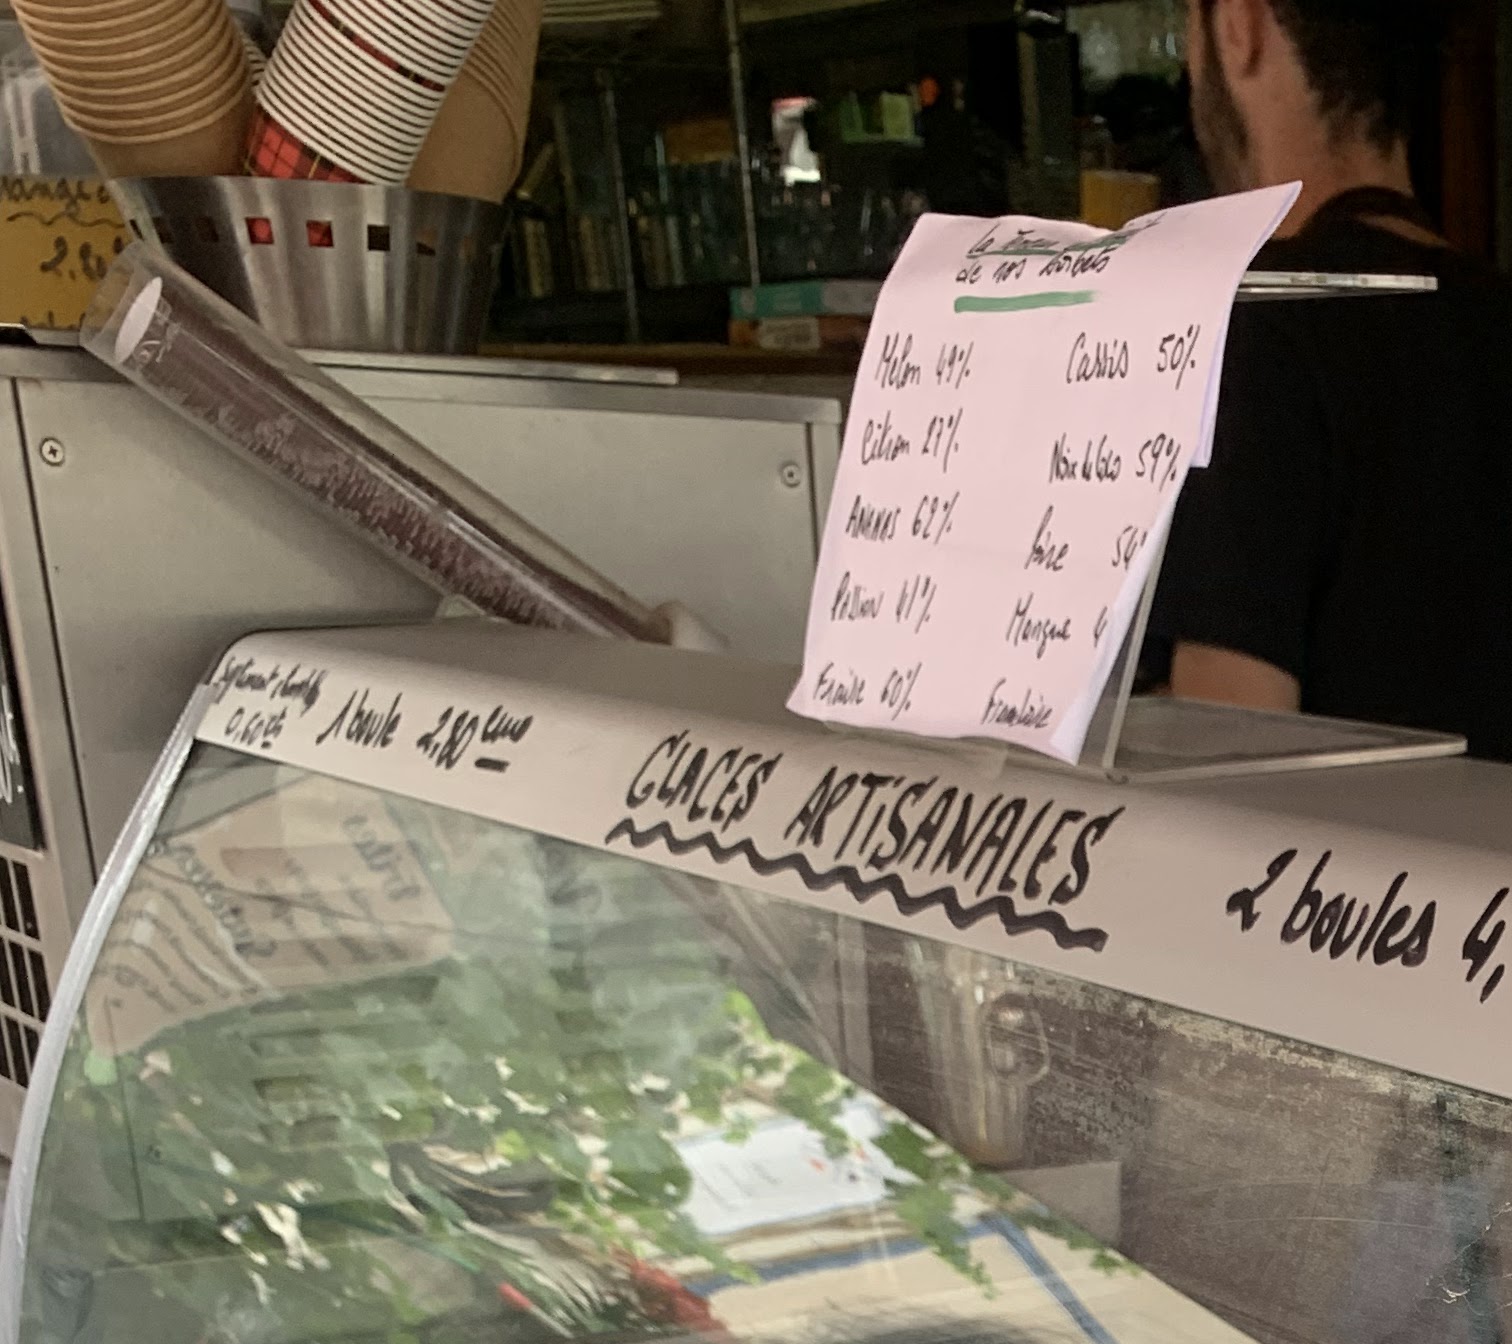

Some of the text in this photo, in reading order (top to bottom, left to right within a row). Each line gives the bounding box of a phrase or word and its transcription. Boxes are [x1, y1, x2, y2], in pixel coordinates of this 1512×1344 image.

[874, 332, 921, 390] Melon
[1066, 324, 1201, 390] Cassis 50%
[861, 410, 910, 466] Citron
[1136, 432, 1181, 492] 59%
[911, 491, 960, 545] 62%
[1111, 525, 1148, 570] 54
[1005, 591, 1071, 660] Mangue
[624, 729, 784, 833] GLACES
[1226, 848, 1299, 933] 2
[1280, 850, 1437, 968] boules
